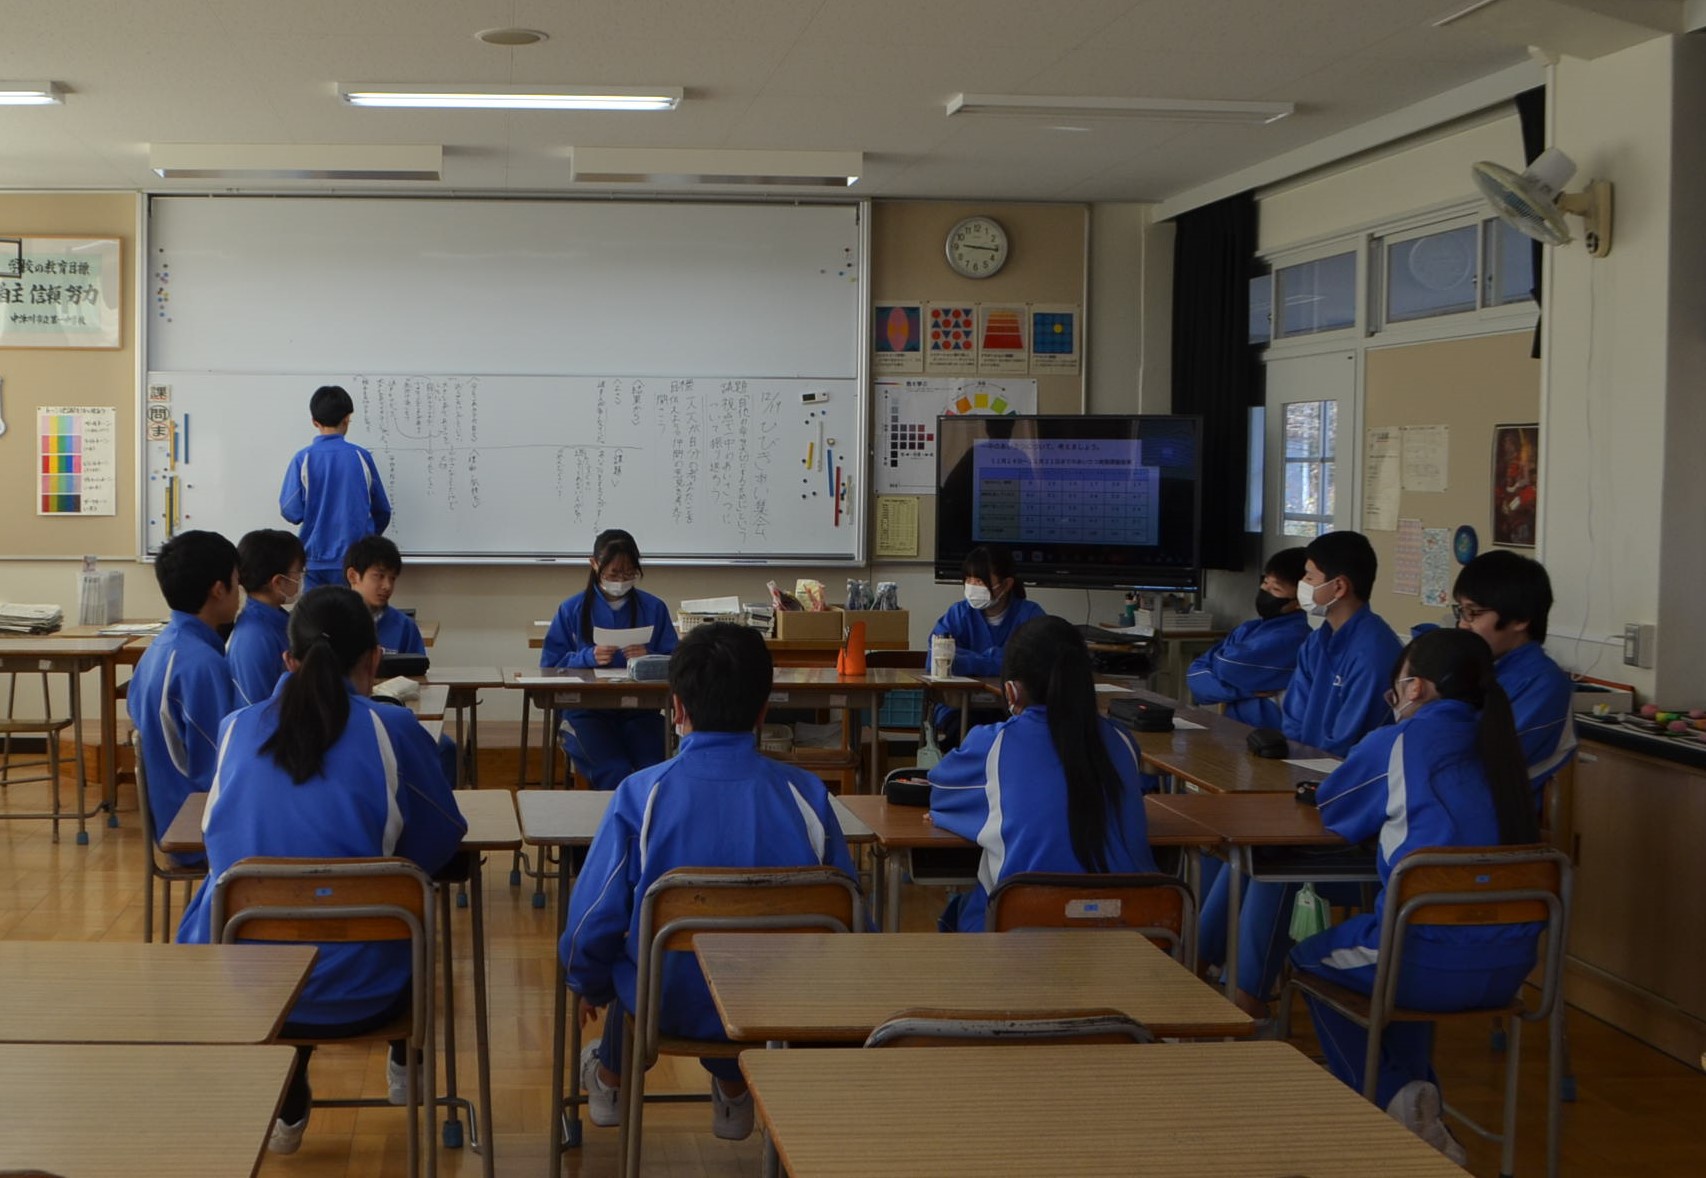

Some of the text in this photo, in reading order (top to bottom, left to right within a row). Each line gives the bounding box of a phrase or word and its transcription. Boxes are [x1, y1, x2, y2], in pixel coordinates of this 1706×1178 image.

[974, 224, 981, 232] 12
[957, 233, 965, 241] 10
[991, 234, 996, 242] 2
[983, 260, 989, 268] 5
[30, 284, 62, 305] 信頼
[65, 284, 99, 305] 努力
[150, 408, 166, 421] 問
[152, 425, 166, 437] ま
